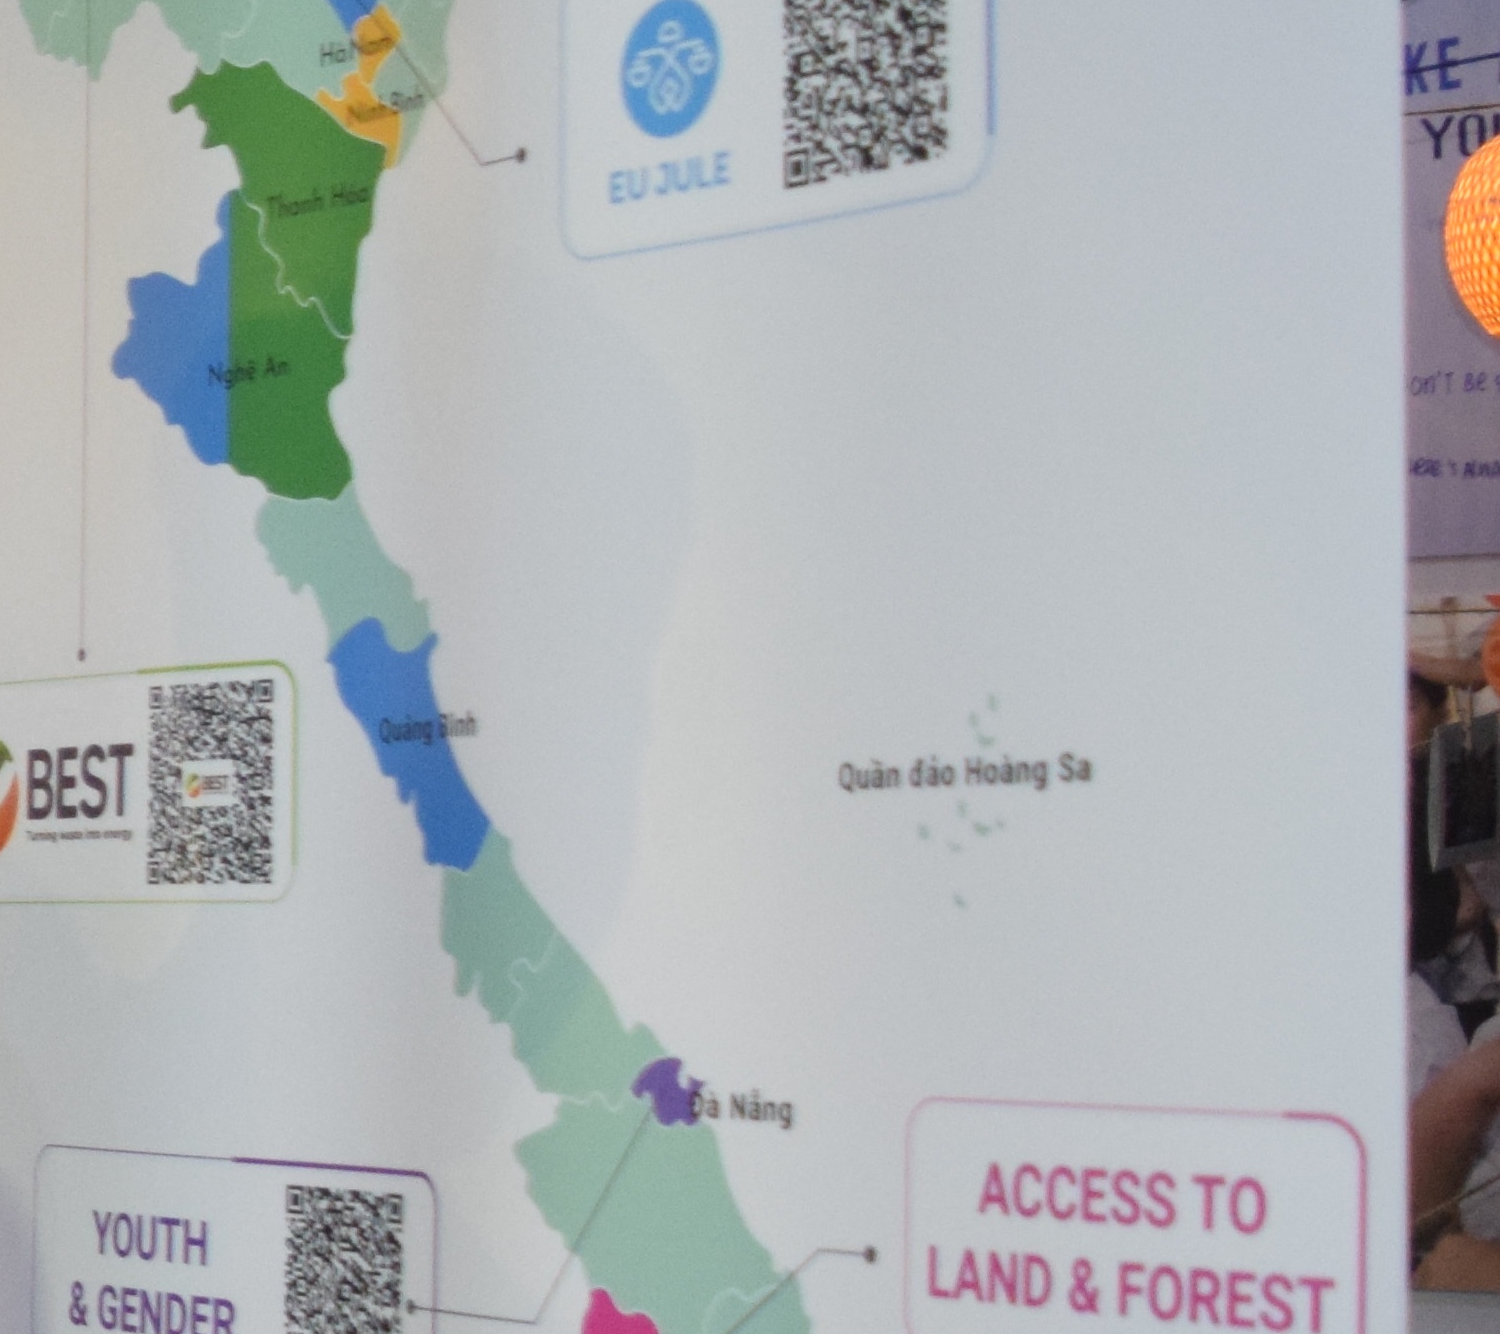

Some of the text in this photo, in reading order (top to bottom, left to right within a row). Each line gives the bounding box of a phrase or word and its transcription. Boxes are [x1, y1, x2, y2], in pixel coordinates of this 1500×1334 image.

[608, 151, 733, 204] EU JULE
[26, 741, 135, 821] BEST
[1057, 751, 1093, 782] Sa
[978, 1161, 1268, 1235] ACCESS TO
[92, 1209, 209, 1266] YOUTH
[68, 1280, 88, 1326] &
[927, 1244, 1337, 1334] LAND & FOREST
